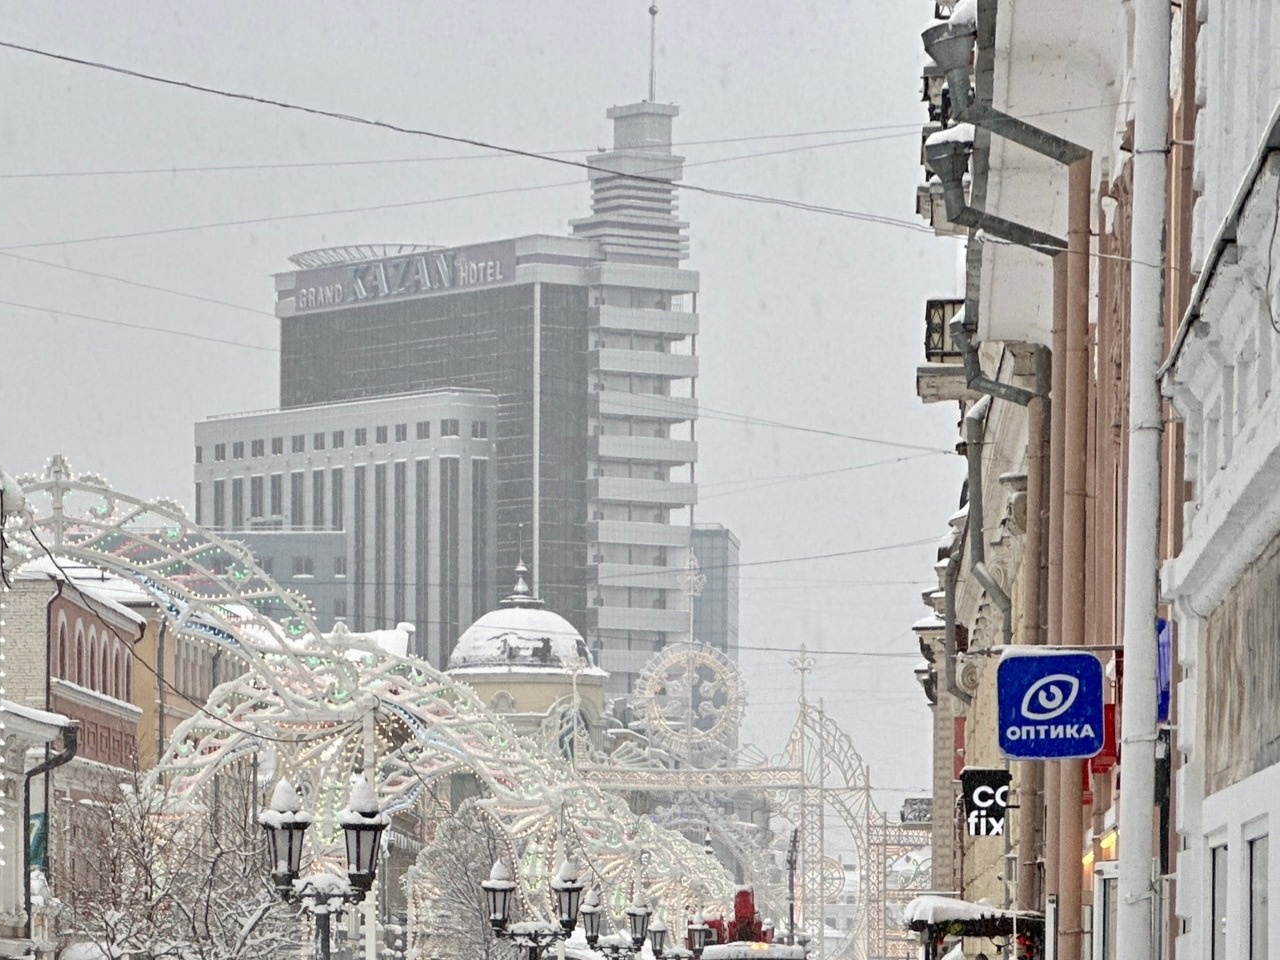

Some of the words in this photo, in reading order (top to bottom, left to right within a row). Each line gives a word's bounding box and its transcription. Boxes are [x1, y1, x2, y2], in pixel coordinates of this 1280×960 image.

[298, 283, 343, 309] GRAND
[347, 251, 456, 301] KAZAN
[458, 259, 504, 287] HOTEL
[1006, 724, 1096, 741] ОПТИКА
[967, 809, 1005, 836] fix
